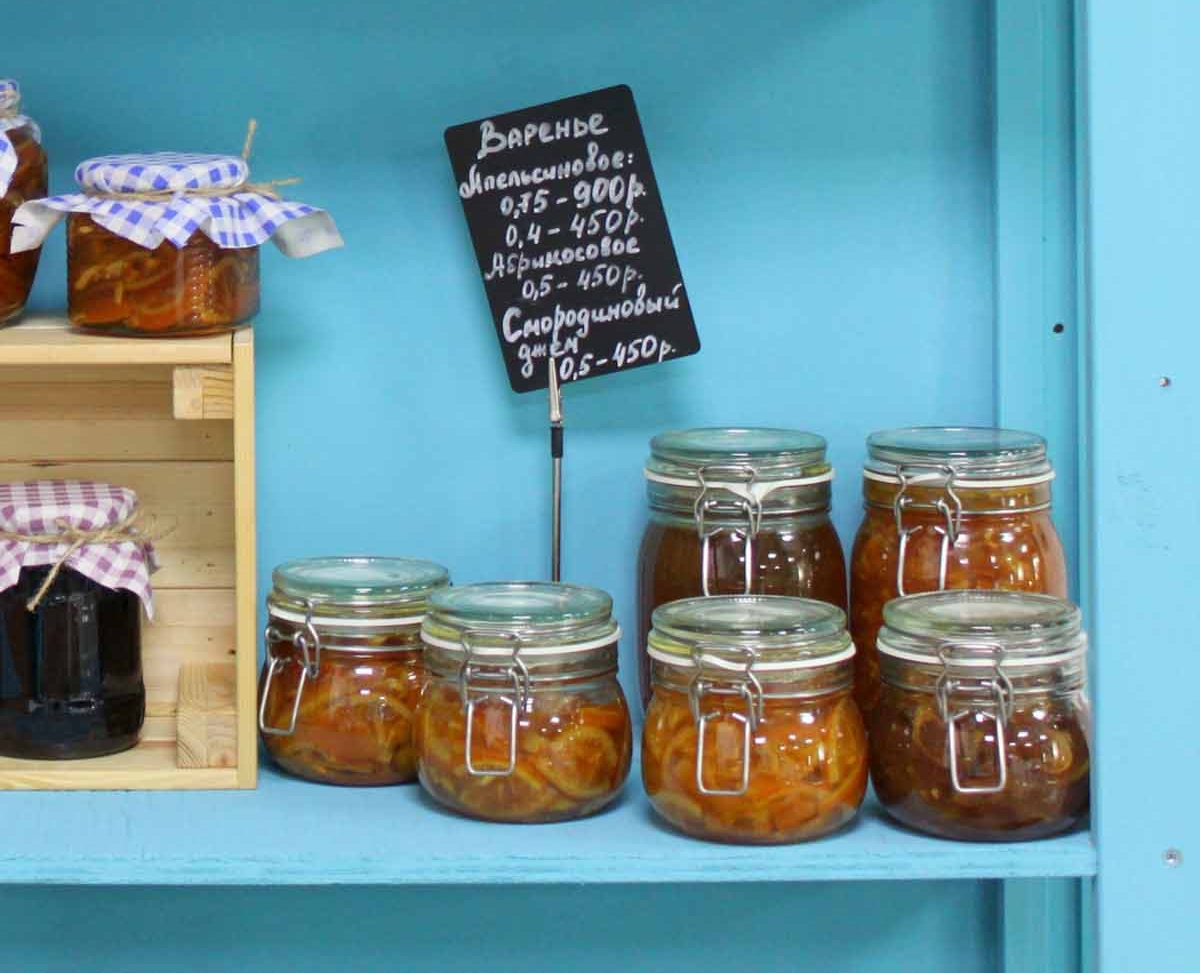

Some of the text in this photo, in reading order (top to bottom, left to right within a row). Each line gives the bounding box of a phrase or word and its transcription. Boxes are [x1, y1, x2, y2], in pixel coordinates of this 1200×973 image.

[505, 223, 541, 249] 0,4
[485, 235, 640, 280] Абрикосовое
[522, 274, 553, 301] 0,5
[502, 282, 683, 345] Смородиновый
[559, 354, 593, 381] 0,5
